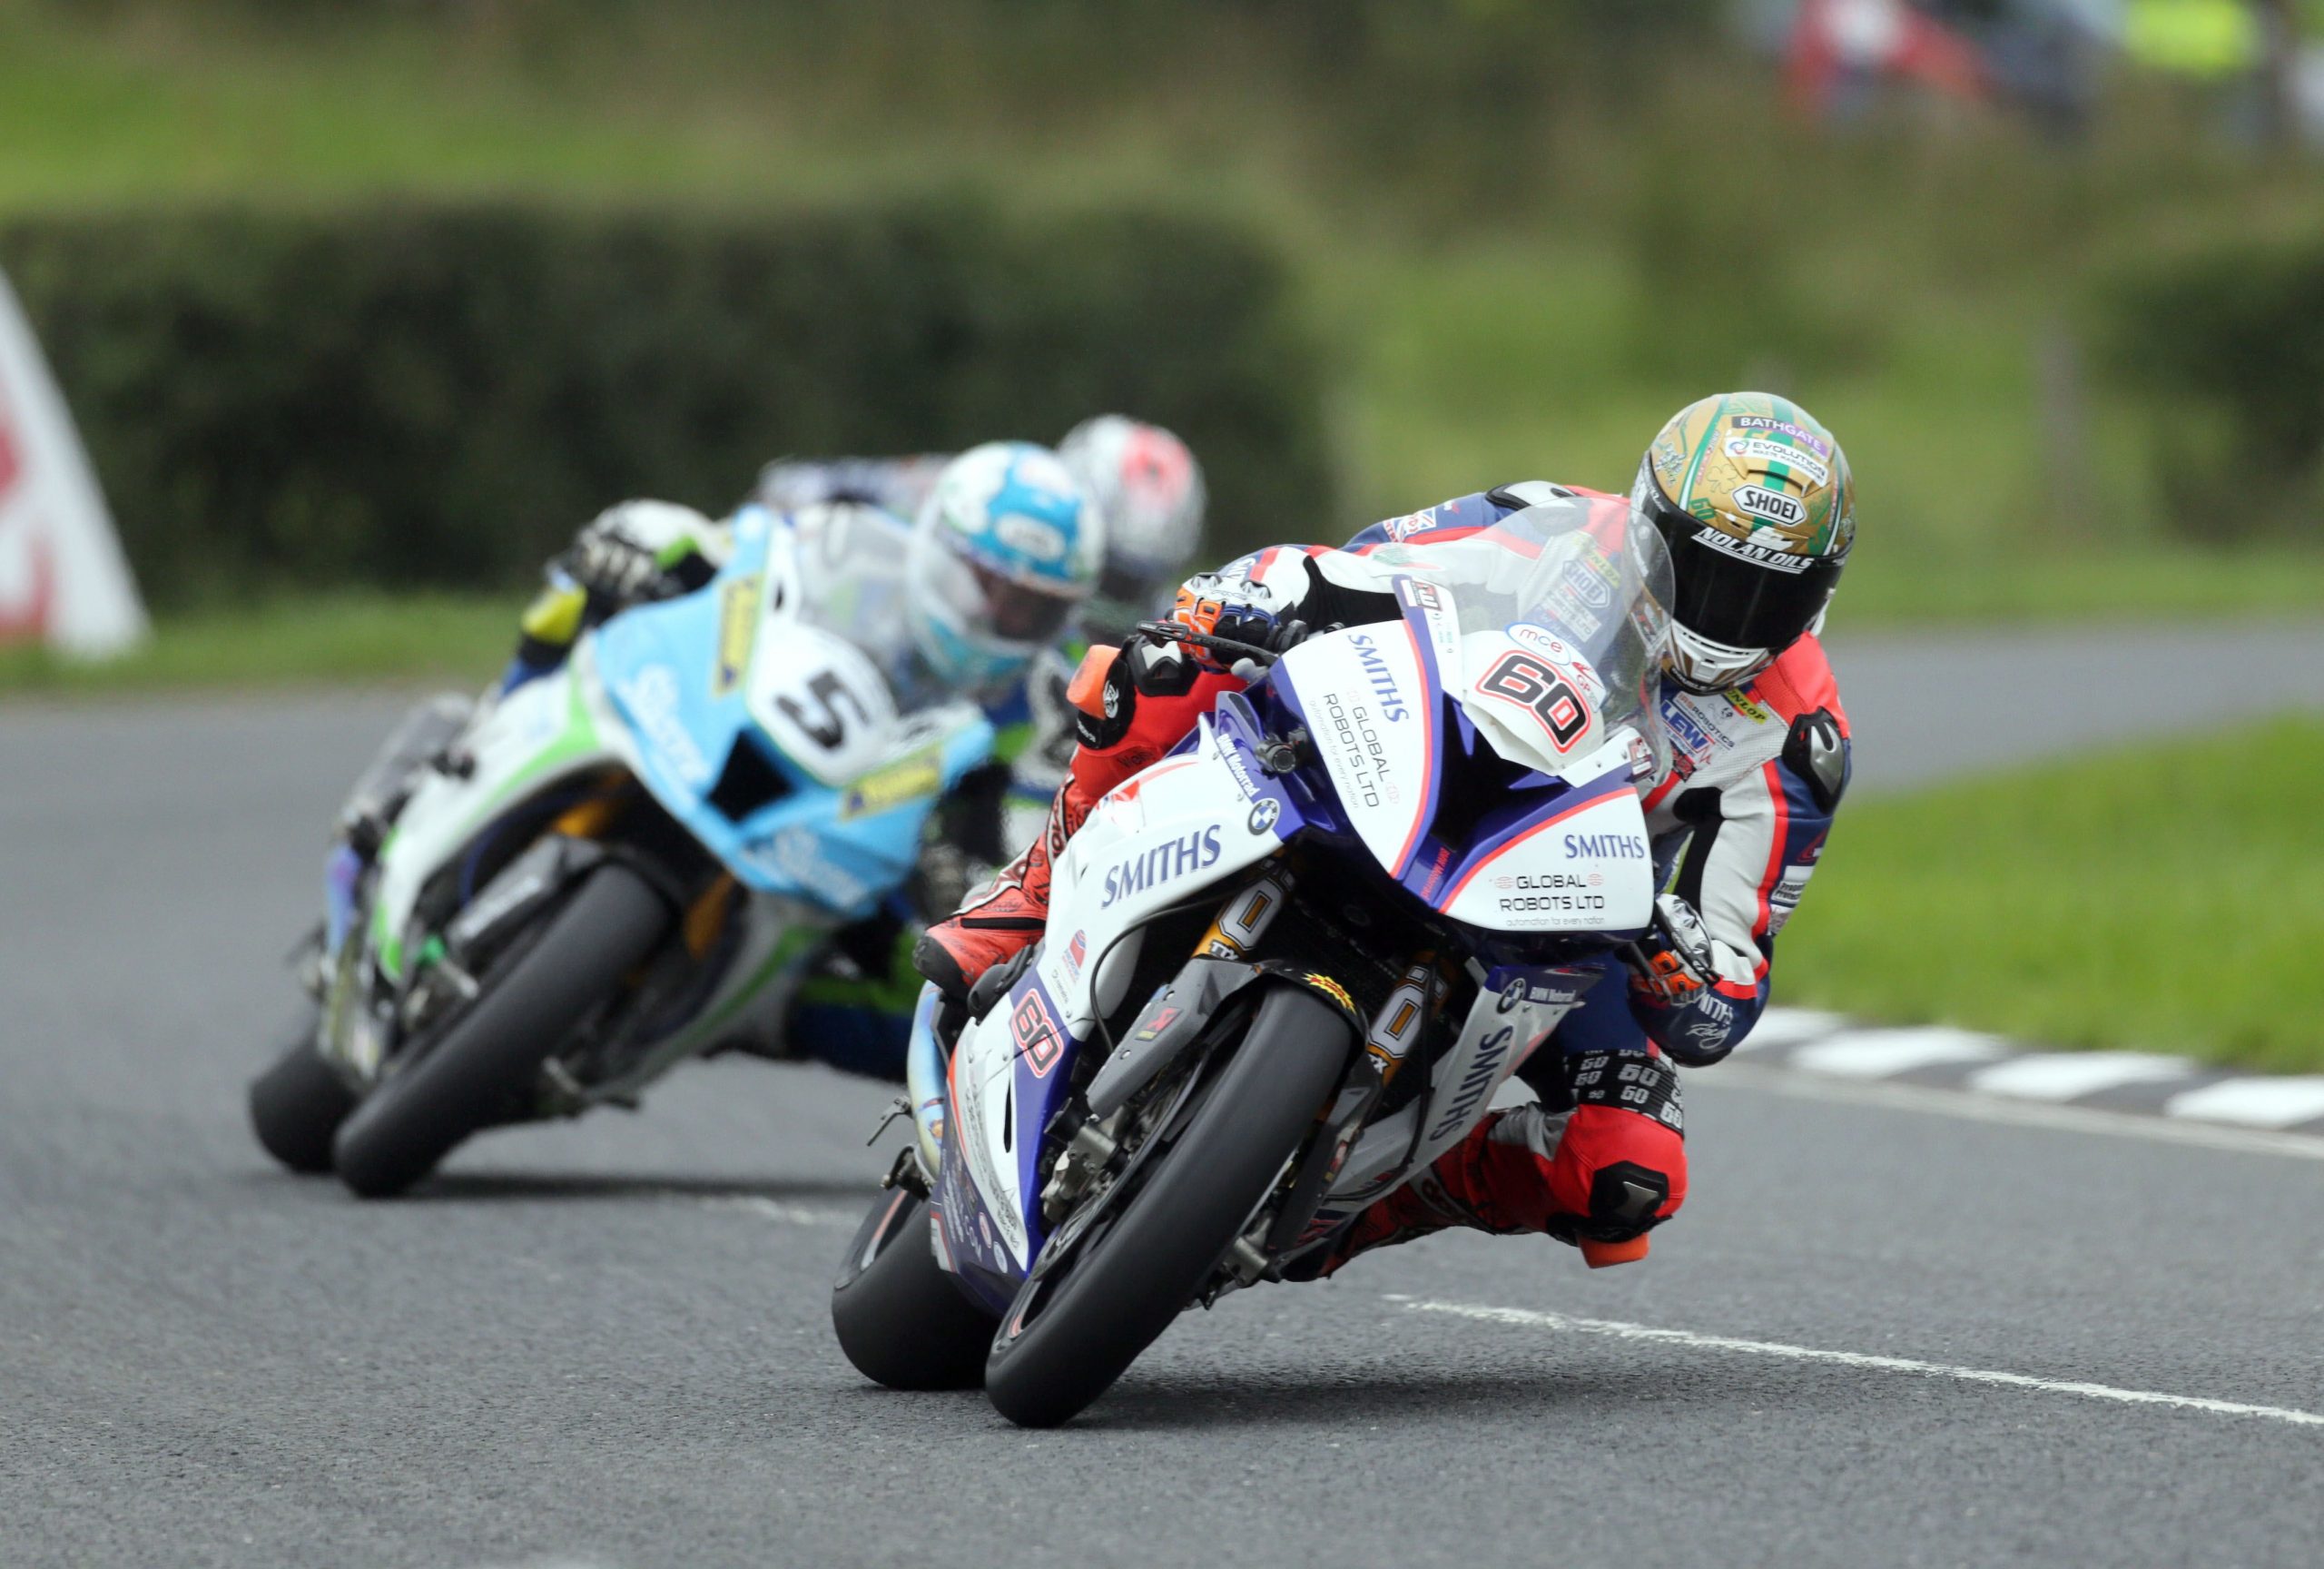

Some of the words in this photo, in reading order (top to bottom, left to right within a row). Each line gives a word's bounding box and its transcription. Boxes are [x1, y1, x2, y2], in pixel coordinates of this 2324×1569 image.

[1739, 417, 1822, 451] BATHGATE
[1753, 441, 1825, 478] EVOLUTION
[1689, 498, 1716, 520] 60
[1743, 489, 1797, 520] SHOEI
[1697, 527, 1768, 562] NOLAN
[1766, 549, 1815, 570] OILS
[1519, 627, 1563, 653] mce
[1347, 634, 1409, 723] SMITHS
[774, 669, 870, 753] 5
[1480, 652, 1589, 750] 60
[1659, 699, 1708, 750] LEW
[1216, 732, 1238, 759] BMW
[1323, 693, 1365, 768] ROBOTS
[1356, 771, 1380, 808] LTD
[1352, 706, 1391, 782] GLOBAL
[1226, 751, 1261, 797] Motorrad
[1344, 780, 1359, 809] nation
[1563, 834, 1645, 859] SMITHS
[1101, 824, 1223, 910] SMITHS
[1515, 874, 1588, 889] GLOBAL
[1499, 896, 1572, 913] ROBOTS
[1575, 894, 1606, 910] LTD
[1505, 918, 1550, 927] automation
[1550, 916, 1561, 925] for
[1561, 917, 1582, 927] every
[1582, 915, 1606, 925] nation
[1014, 993, 1060, 1075] 60
[1428, 1025, 1514, 1142] SMITHS
[1618, 1063, 1661, 1088] 60
[1620, 1085, 1650, 1105] 60
